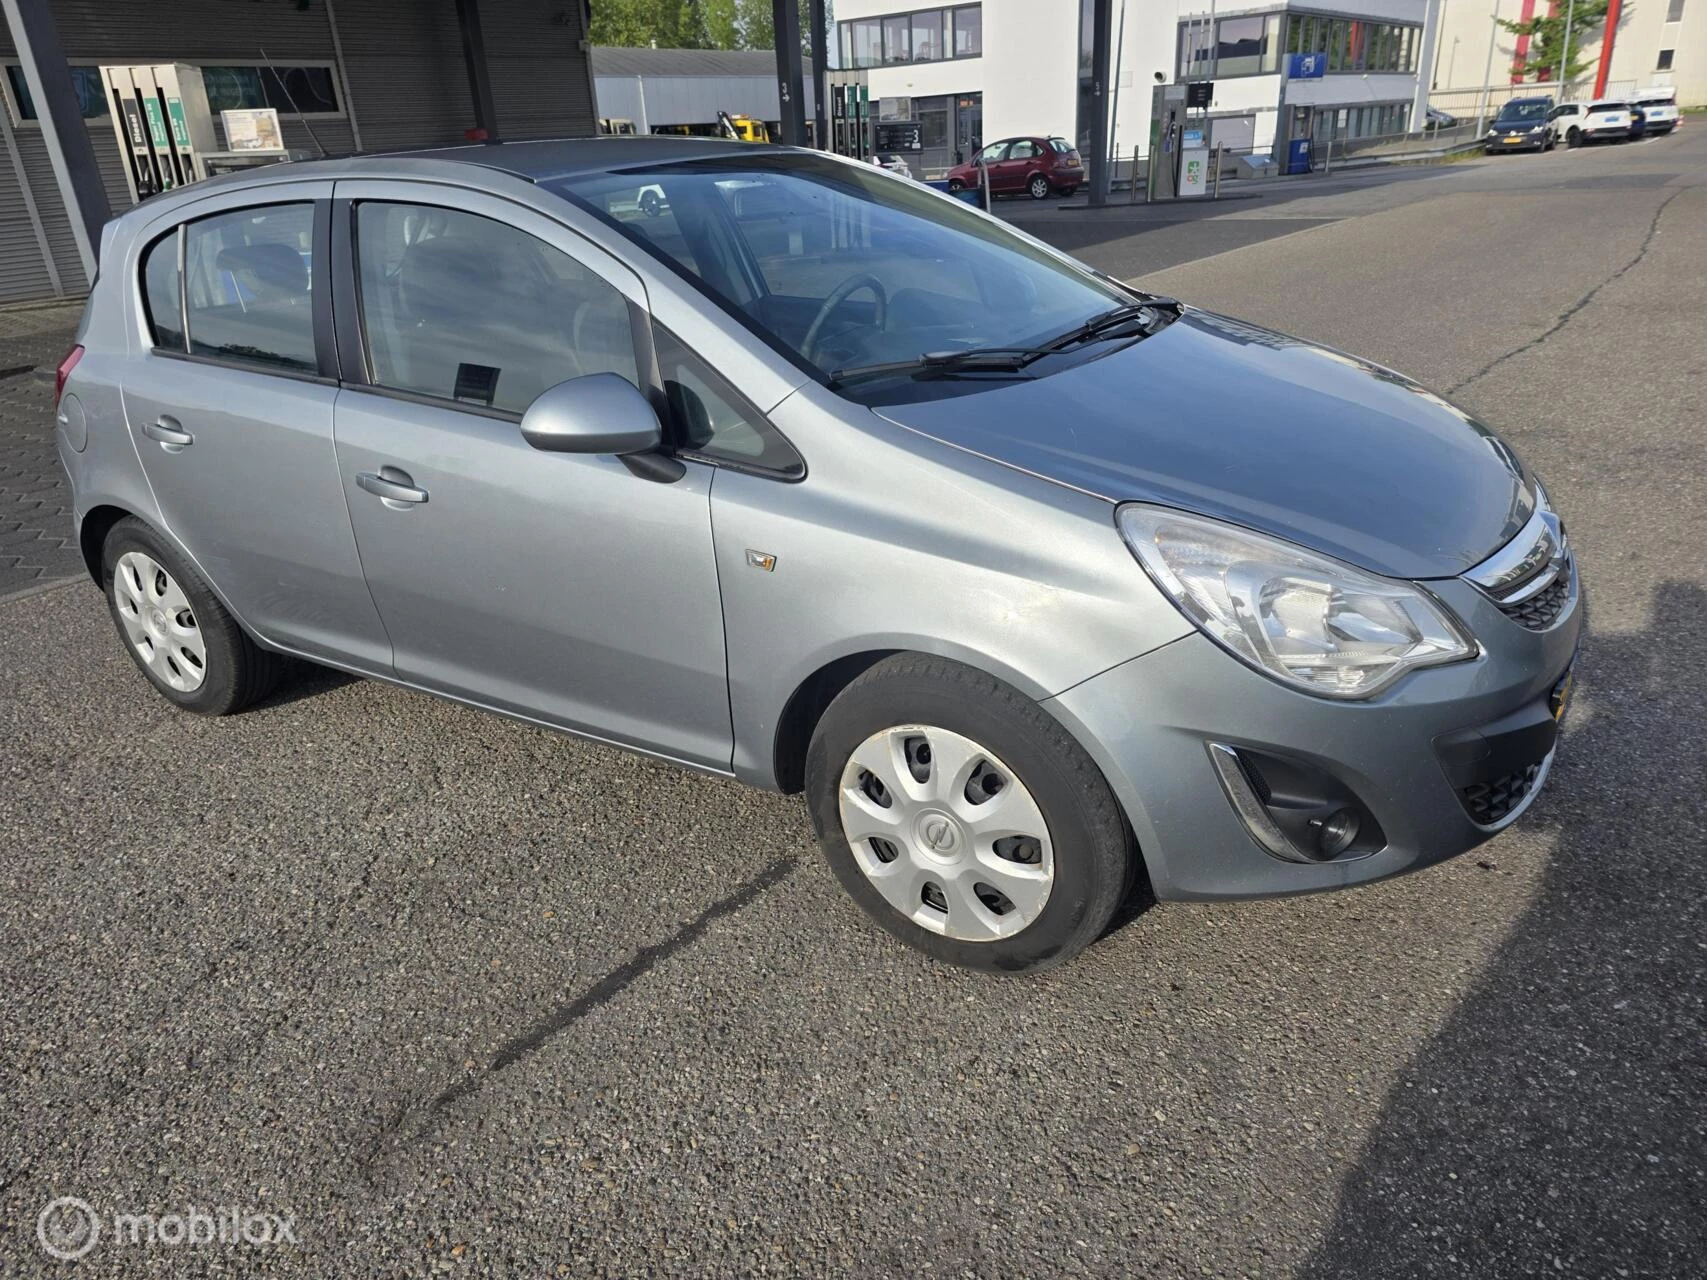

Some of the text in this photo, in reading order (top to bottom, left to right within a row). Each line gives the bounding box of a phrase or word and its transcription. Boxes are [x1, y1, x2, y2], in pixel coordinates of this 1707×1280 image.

[781, 82, 788, 94] 3
[129, 114, 142, 142] Diesel
[913, 129, 919, 143] 3
